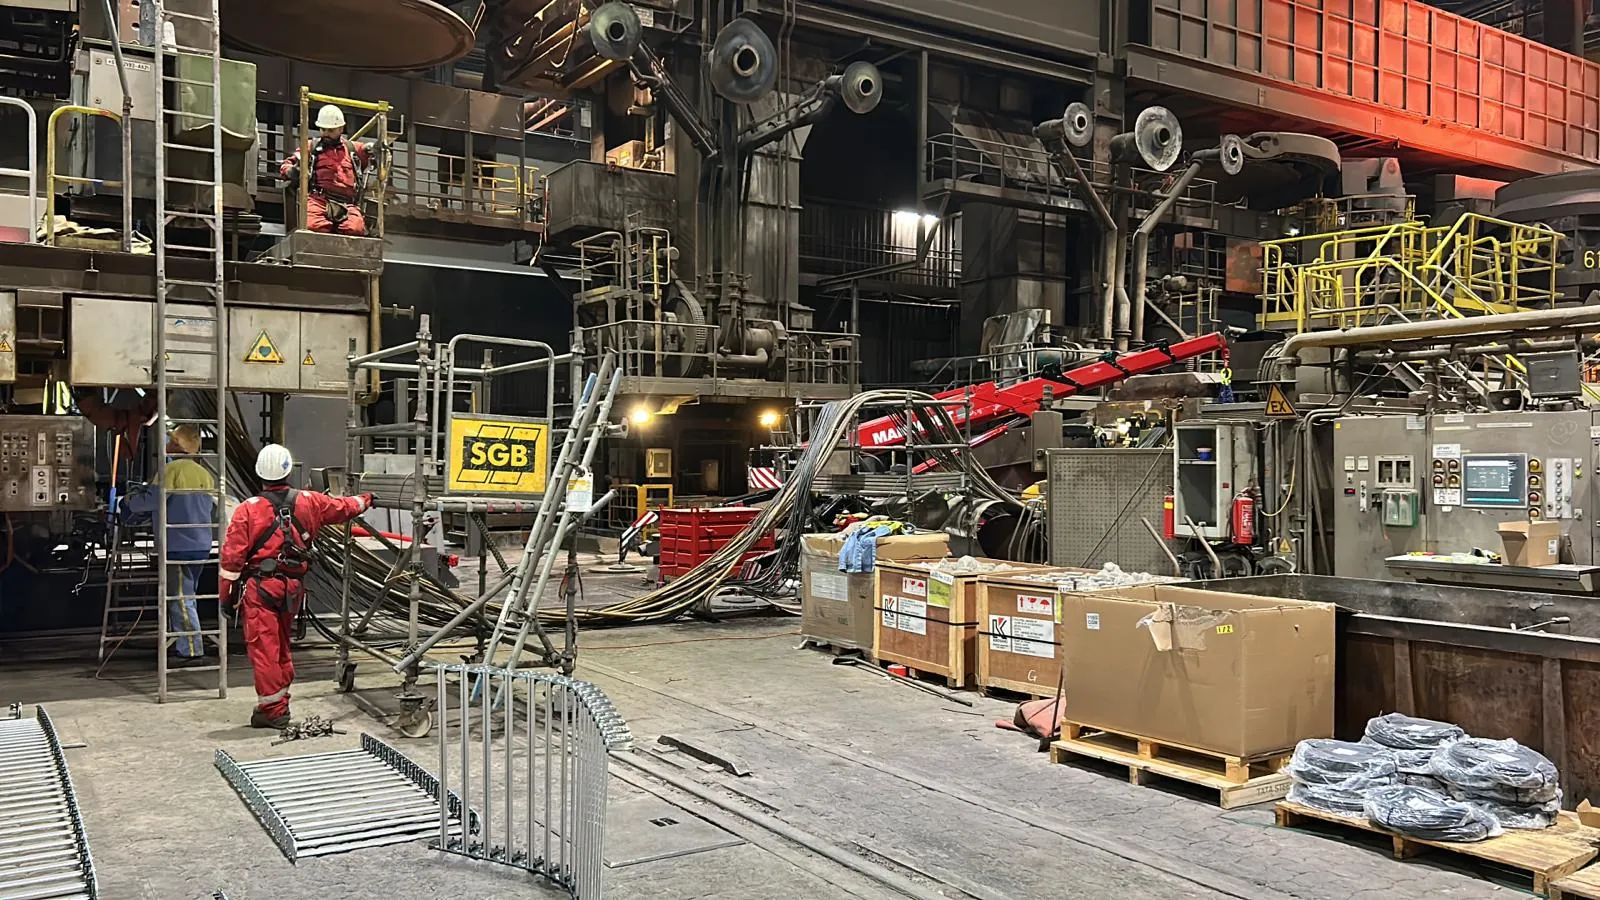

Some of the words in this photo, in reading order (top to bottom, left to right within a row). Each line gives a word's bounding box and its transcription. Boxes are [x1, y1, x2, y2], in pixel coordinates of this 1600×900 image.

[1271, 401, 1286, 412] EX
[470, 442, 528, 467] SGB
[1027, 669, 1037, 682] G
[1256, 785, 1273, 795] TATA
